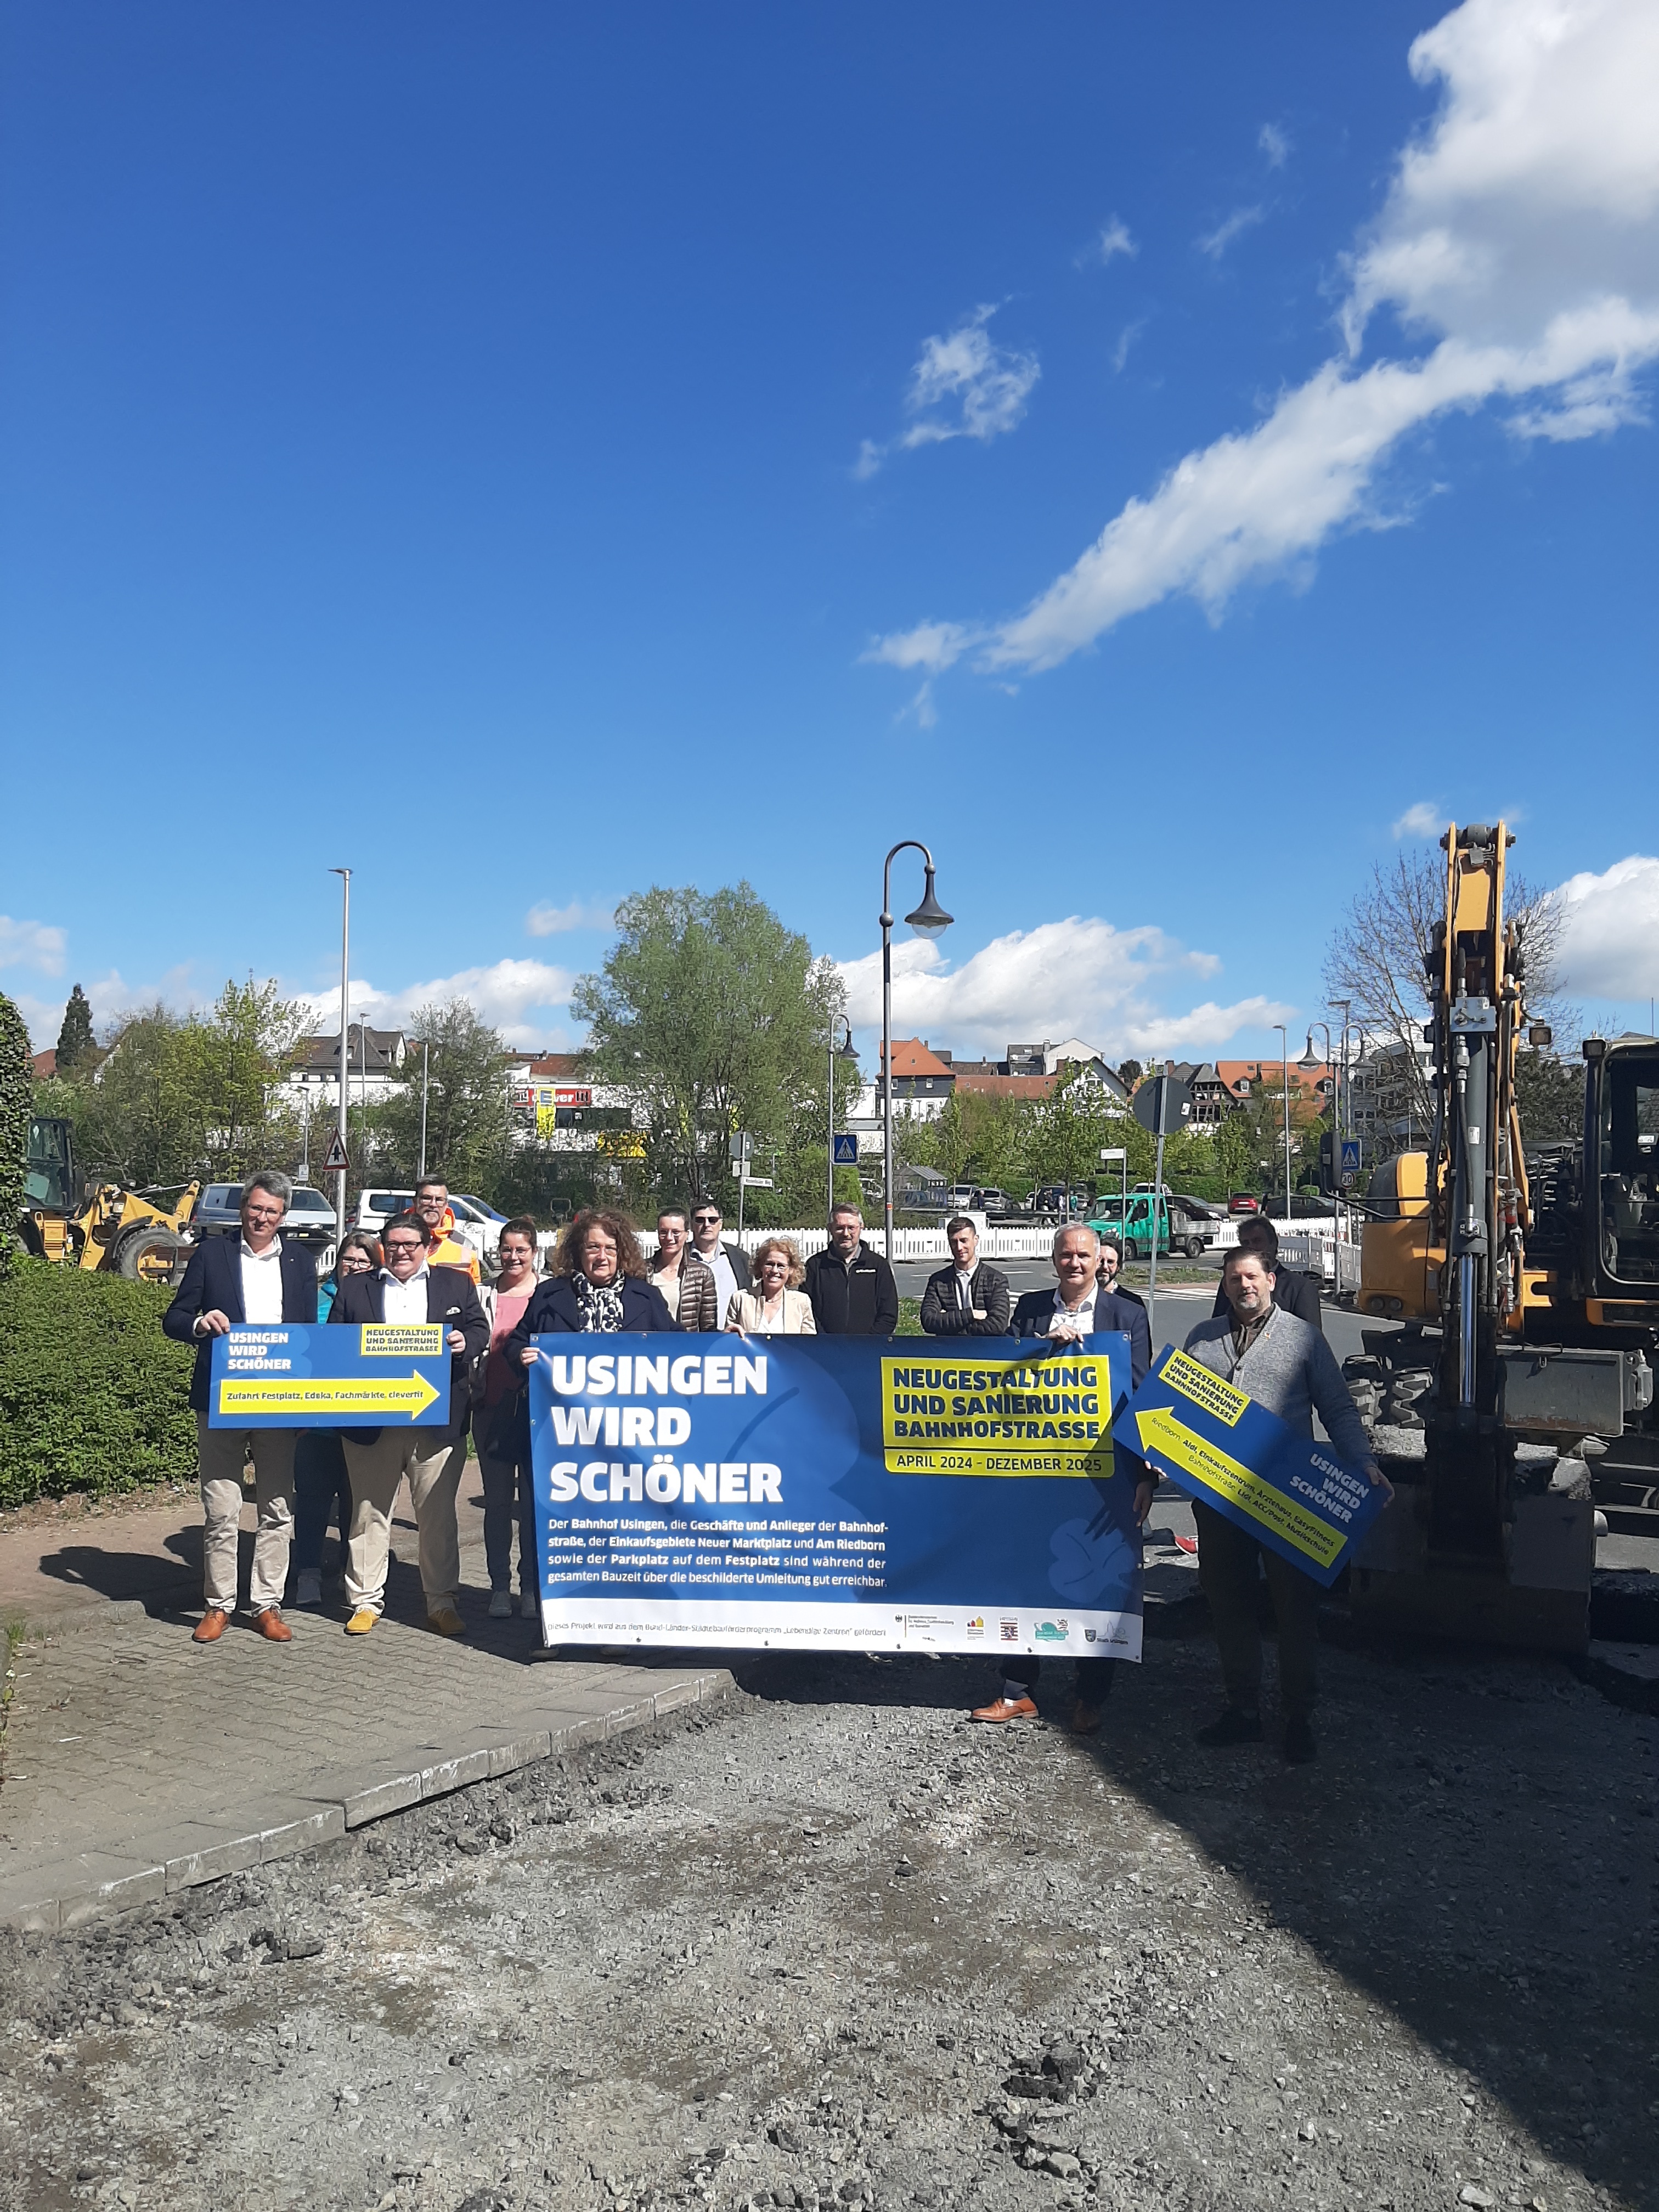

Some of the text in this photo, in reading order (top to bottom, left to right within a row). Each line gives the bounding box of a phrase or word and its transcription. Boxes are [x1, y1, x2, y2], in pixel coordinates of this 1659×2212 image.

[1342, 1175, 1352, 1183] 30
[229, 1333, 289, 1343] USINGEN
[229, 1345, 267, 1356] WIRD
[228, 1357, 291, 1369] SCHÖNER
[552, 1355, 767, 1395] USINGEN
[893, 1366, 1097, 1391] NEUGESTALTUNG
[1173, 1356, 1244, 1407] NEUGESTALTUNG
[262, 1392, 303, 1401] Festplatz,
[305, 1392, 333, 1400] Edeka,
[1164, 1372, 1234, 1421] BAHNHOFSTRASSE
[1170, 1364, 1239, 1414] UND SANIERUNG
[894, 1393, 1099, 1416] UND SANIERUNG
[551, 1407, 691, 1446] WIRD
[894, 1420, 1100, 1438] BAHNHOFSTRASSE
[897, 1455, 936, 1468] APRIL
[940, 1456, 973, 1469] 2024
[986, 1458, 1062, 1471] DEZEMBER
[1066, 1458, 1102, 1471] 2025
[550, 1454, 783, 1503] SCHÖNER
[1310, 1453, 1369, 1498] USINGEN
[1290, 1475, 1352, 1523] SCHÖNER
[1323, 1477, 1361, 1509] WIRD
[549, 1519, 888, 1533] Der Bahnhof Usingen, die Geschäfte und Anlieger der Bahnhof-
[549, 1536, 885, 1551] straße, der Einkaufsgebiete Neuer Marktplatz und Am Riedborn
[549, 1554, 886, 1568] sowie der Parkplatz auf dem Festplatz sind während der
[548, 1571, 887, 1587] gesamten Bauzeit über die beschilderte Umleitung gut erreichbar.
